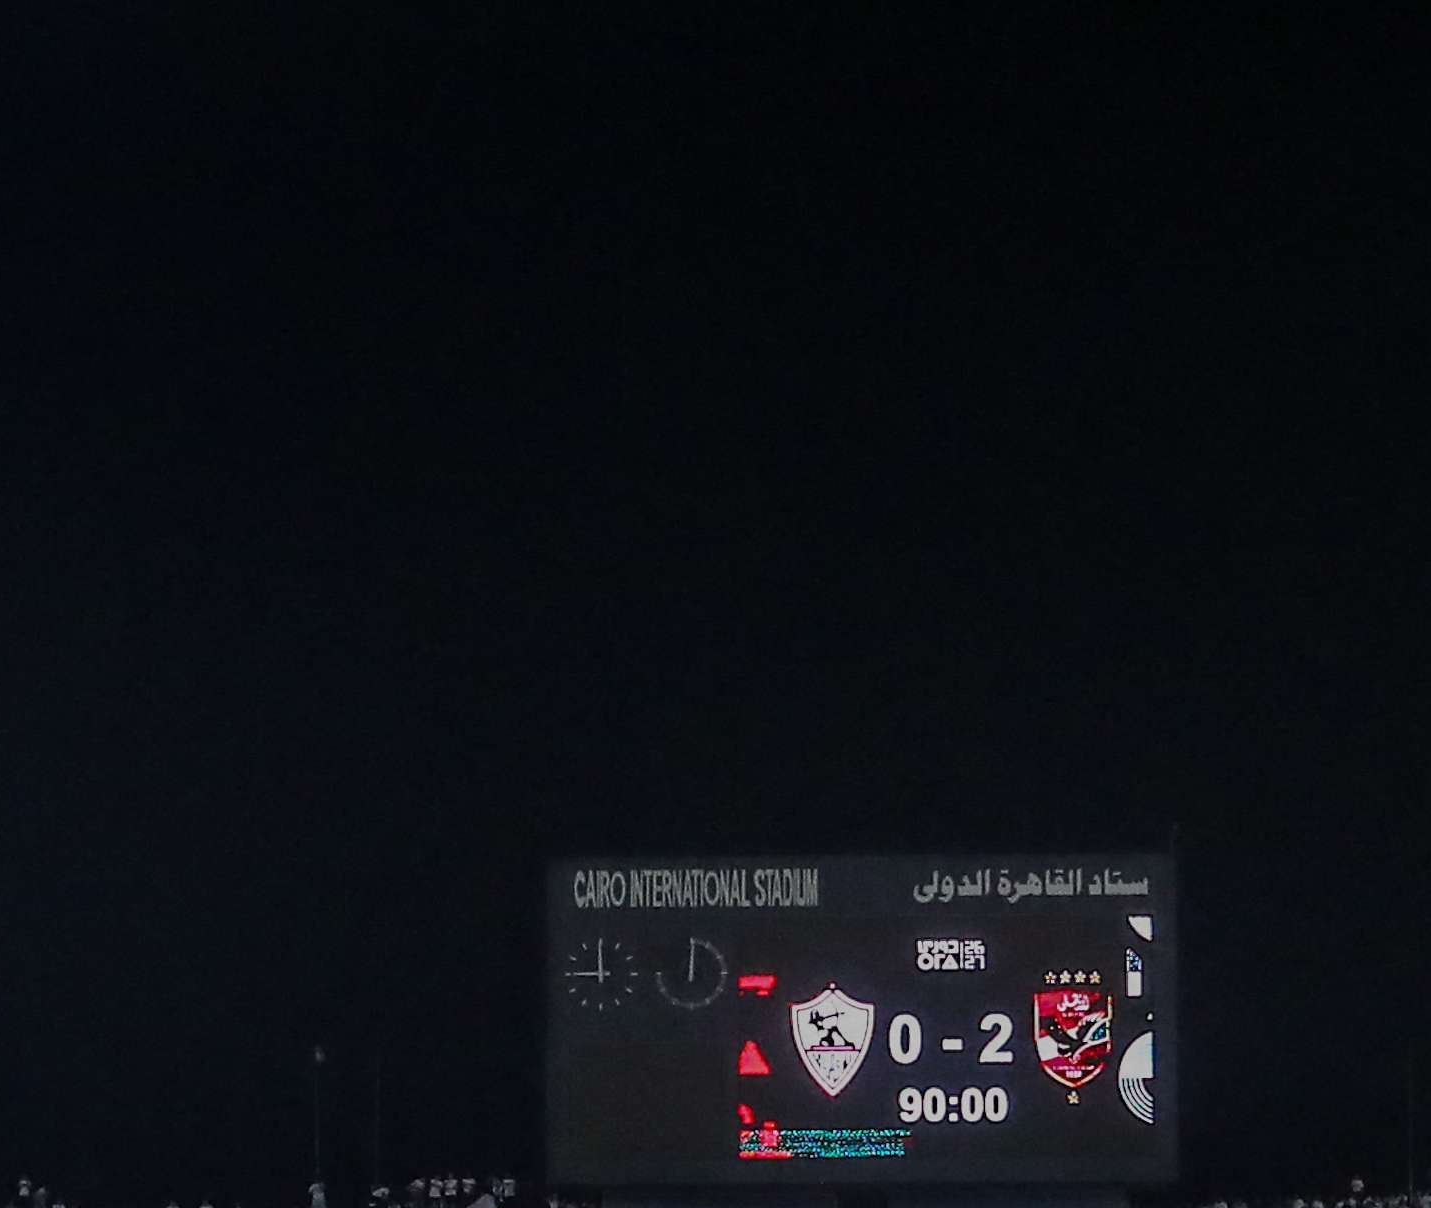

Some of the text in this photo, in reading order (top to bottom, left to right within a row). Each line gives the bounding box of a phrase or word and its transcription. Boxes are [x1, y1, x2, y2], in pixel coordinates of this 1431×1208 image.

[574, 868, 819, 907] CAIRO INTERNATIONAL STADIUM
[999, 868, 1083, 902] القاهرة
[1088, 872, 1149, 897] ستاد
[888, 1013, 922, 1064] 0
[979, 1012, 1014, 1064] 2
[898, 1087, 1009, 1123] 90:00
